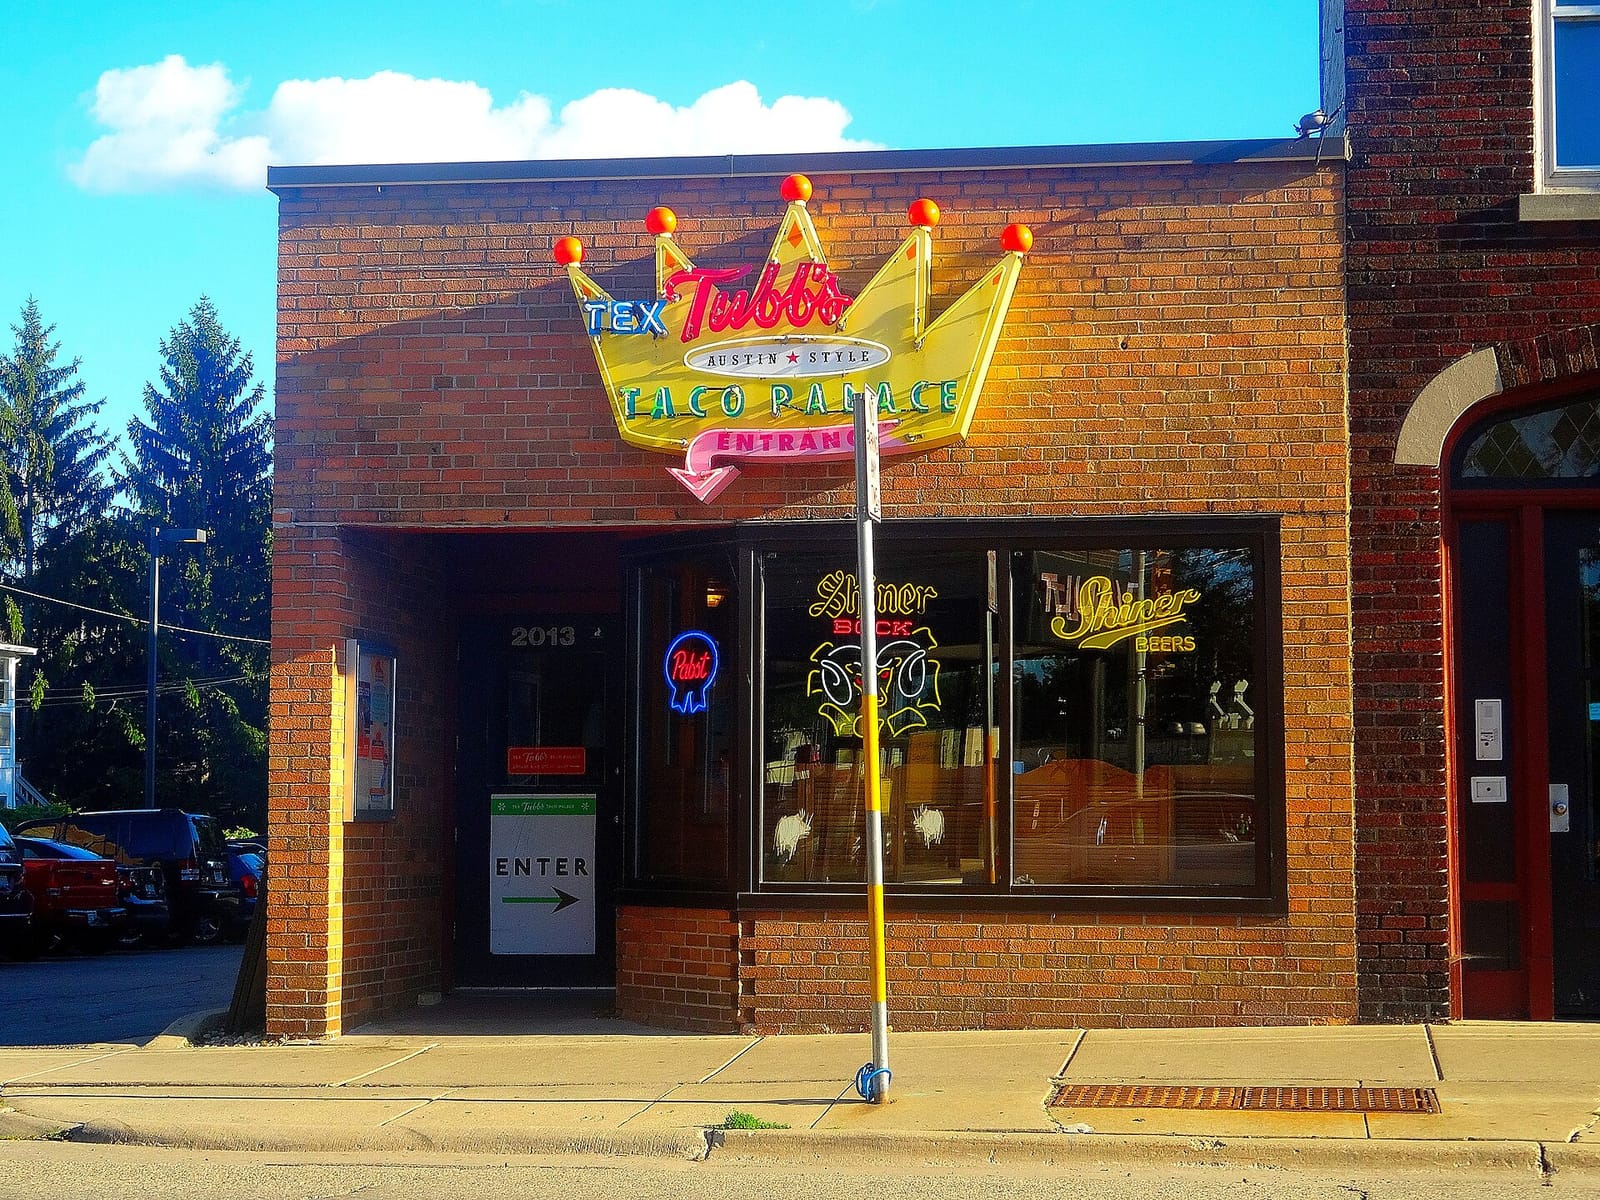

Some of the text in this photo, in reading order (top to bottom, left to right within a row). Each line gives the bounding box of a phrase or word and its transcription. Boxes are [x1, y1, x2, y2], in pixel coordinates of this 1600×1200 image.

[584, 263, 854, 343] TEX Tubb's
[707, 350, 870, 367] AUSTIN STYLE
[619, 380, 958, 420] TACO PALACE
[717, 430, 855, 452] ENTRAN
[808, 570, 938, 618] Shner
[1050, 575, 1201, 640] Shiner
[511, 626, 576, 646] 2013
[1135, 635, 1196, 653] BEERS
[672, 650, 711, 681] Pabst
[496, 858, 588, 876] ENTER
